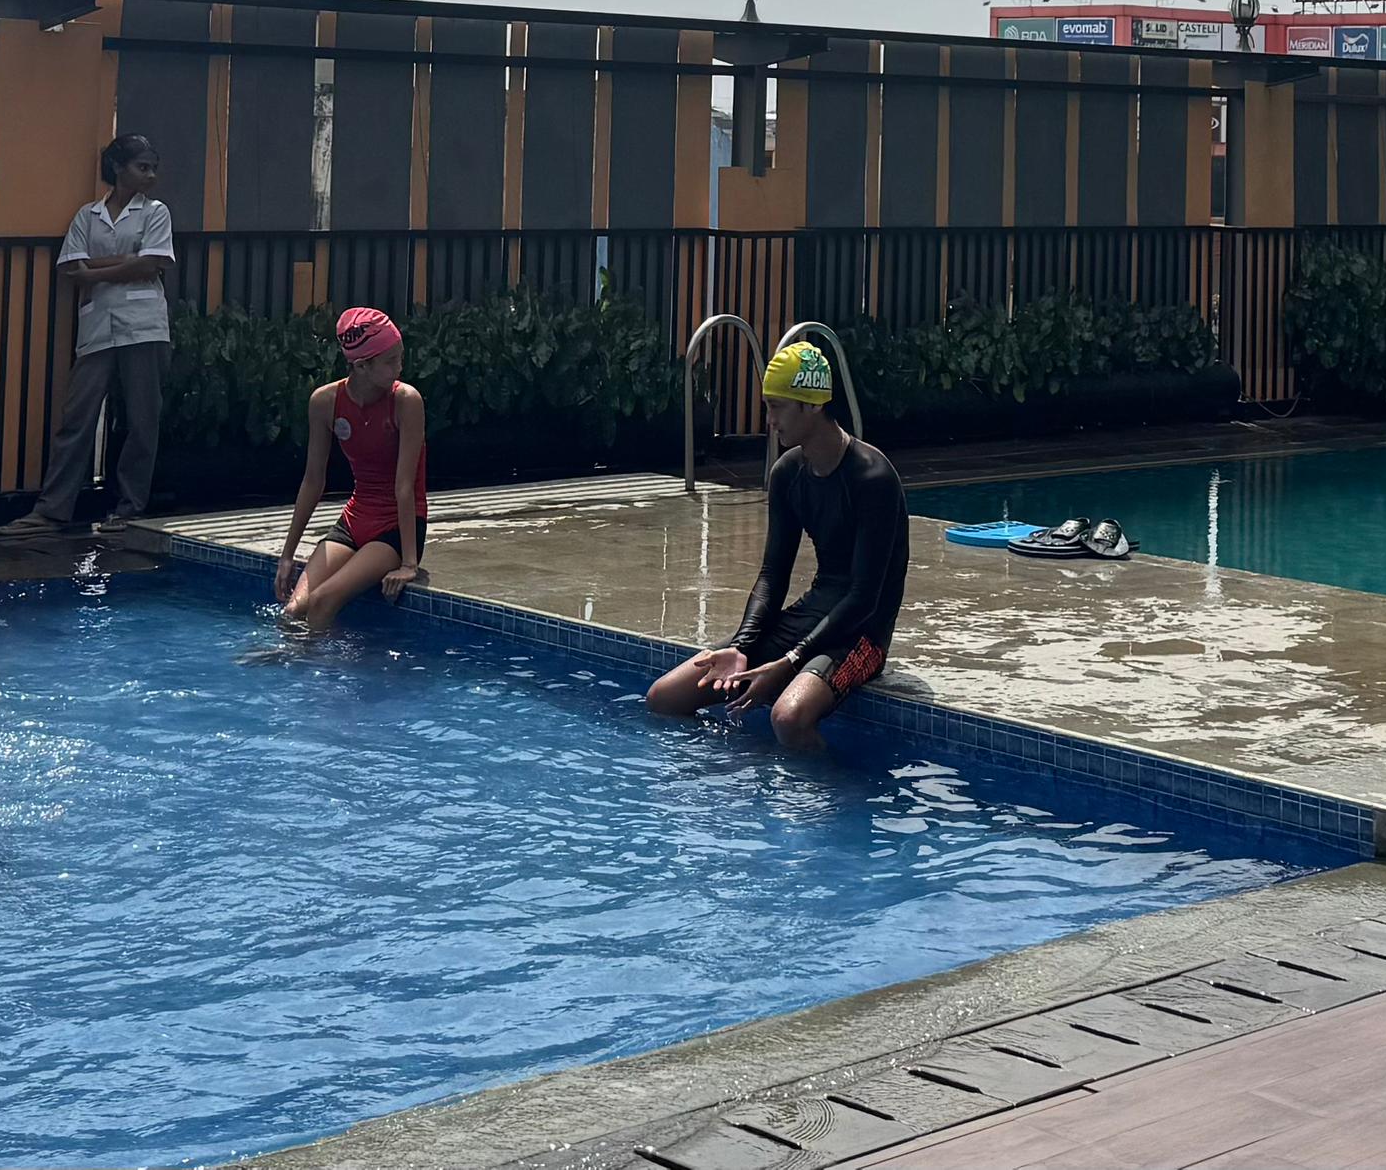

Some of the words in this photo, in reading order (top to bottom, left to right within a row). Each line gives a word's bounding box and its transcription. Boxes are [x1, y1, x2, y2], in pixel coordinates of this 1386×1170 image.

[1062, 22, 1107, 34] evomab
[1177, 23, 1220, 34] CASTELLI
[1342, 41, 1366, 54] Dulux
